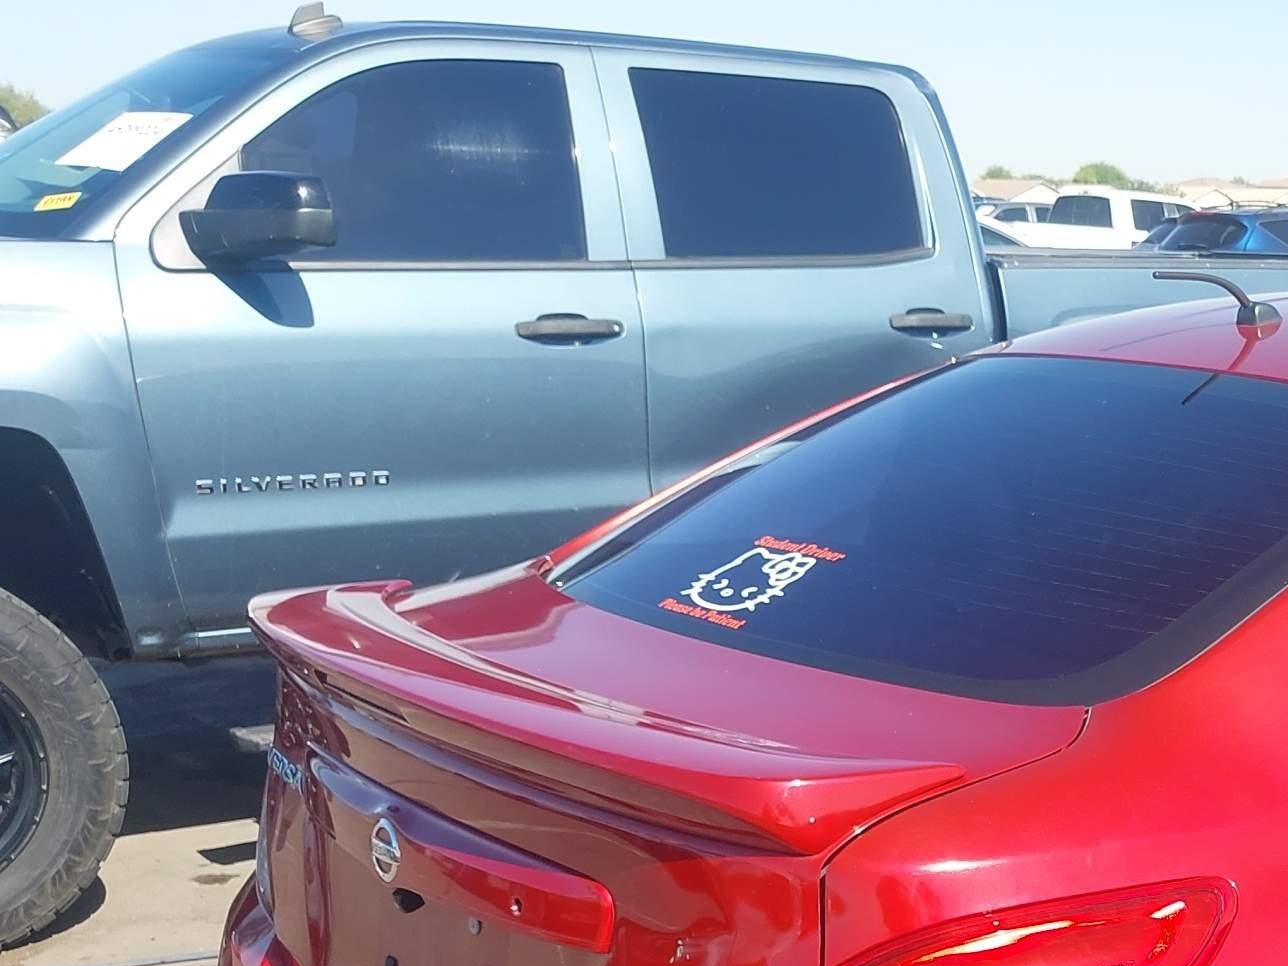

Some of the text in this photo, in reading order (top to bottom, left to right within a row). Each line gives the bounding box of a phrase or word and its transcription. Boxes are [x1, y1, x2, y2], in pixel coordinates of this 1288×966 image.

[195, 470, 391, 496] SILVERADO
[754, 535, 846, 562] Student Driver
[657, 598, 694, 614] Please
[702, 610, 746, 630] Patient
